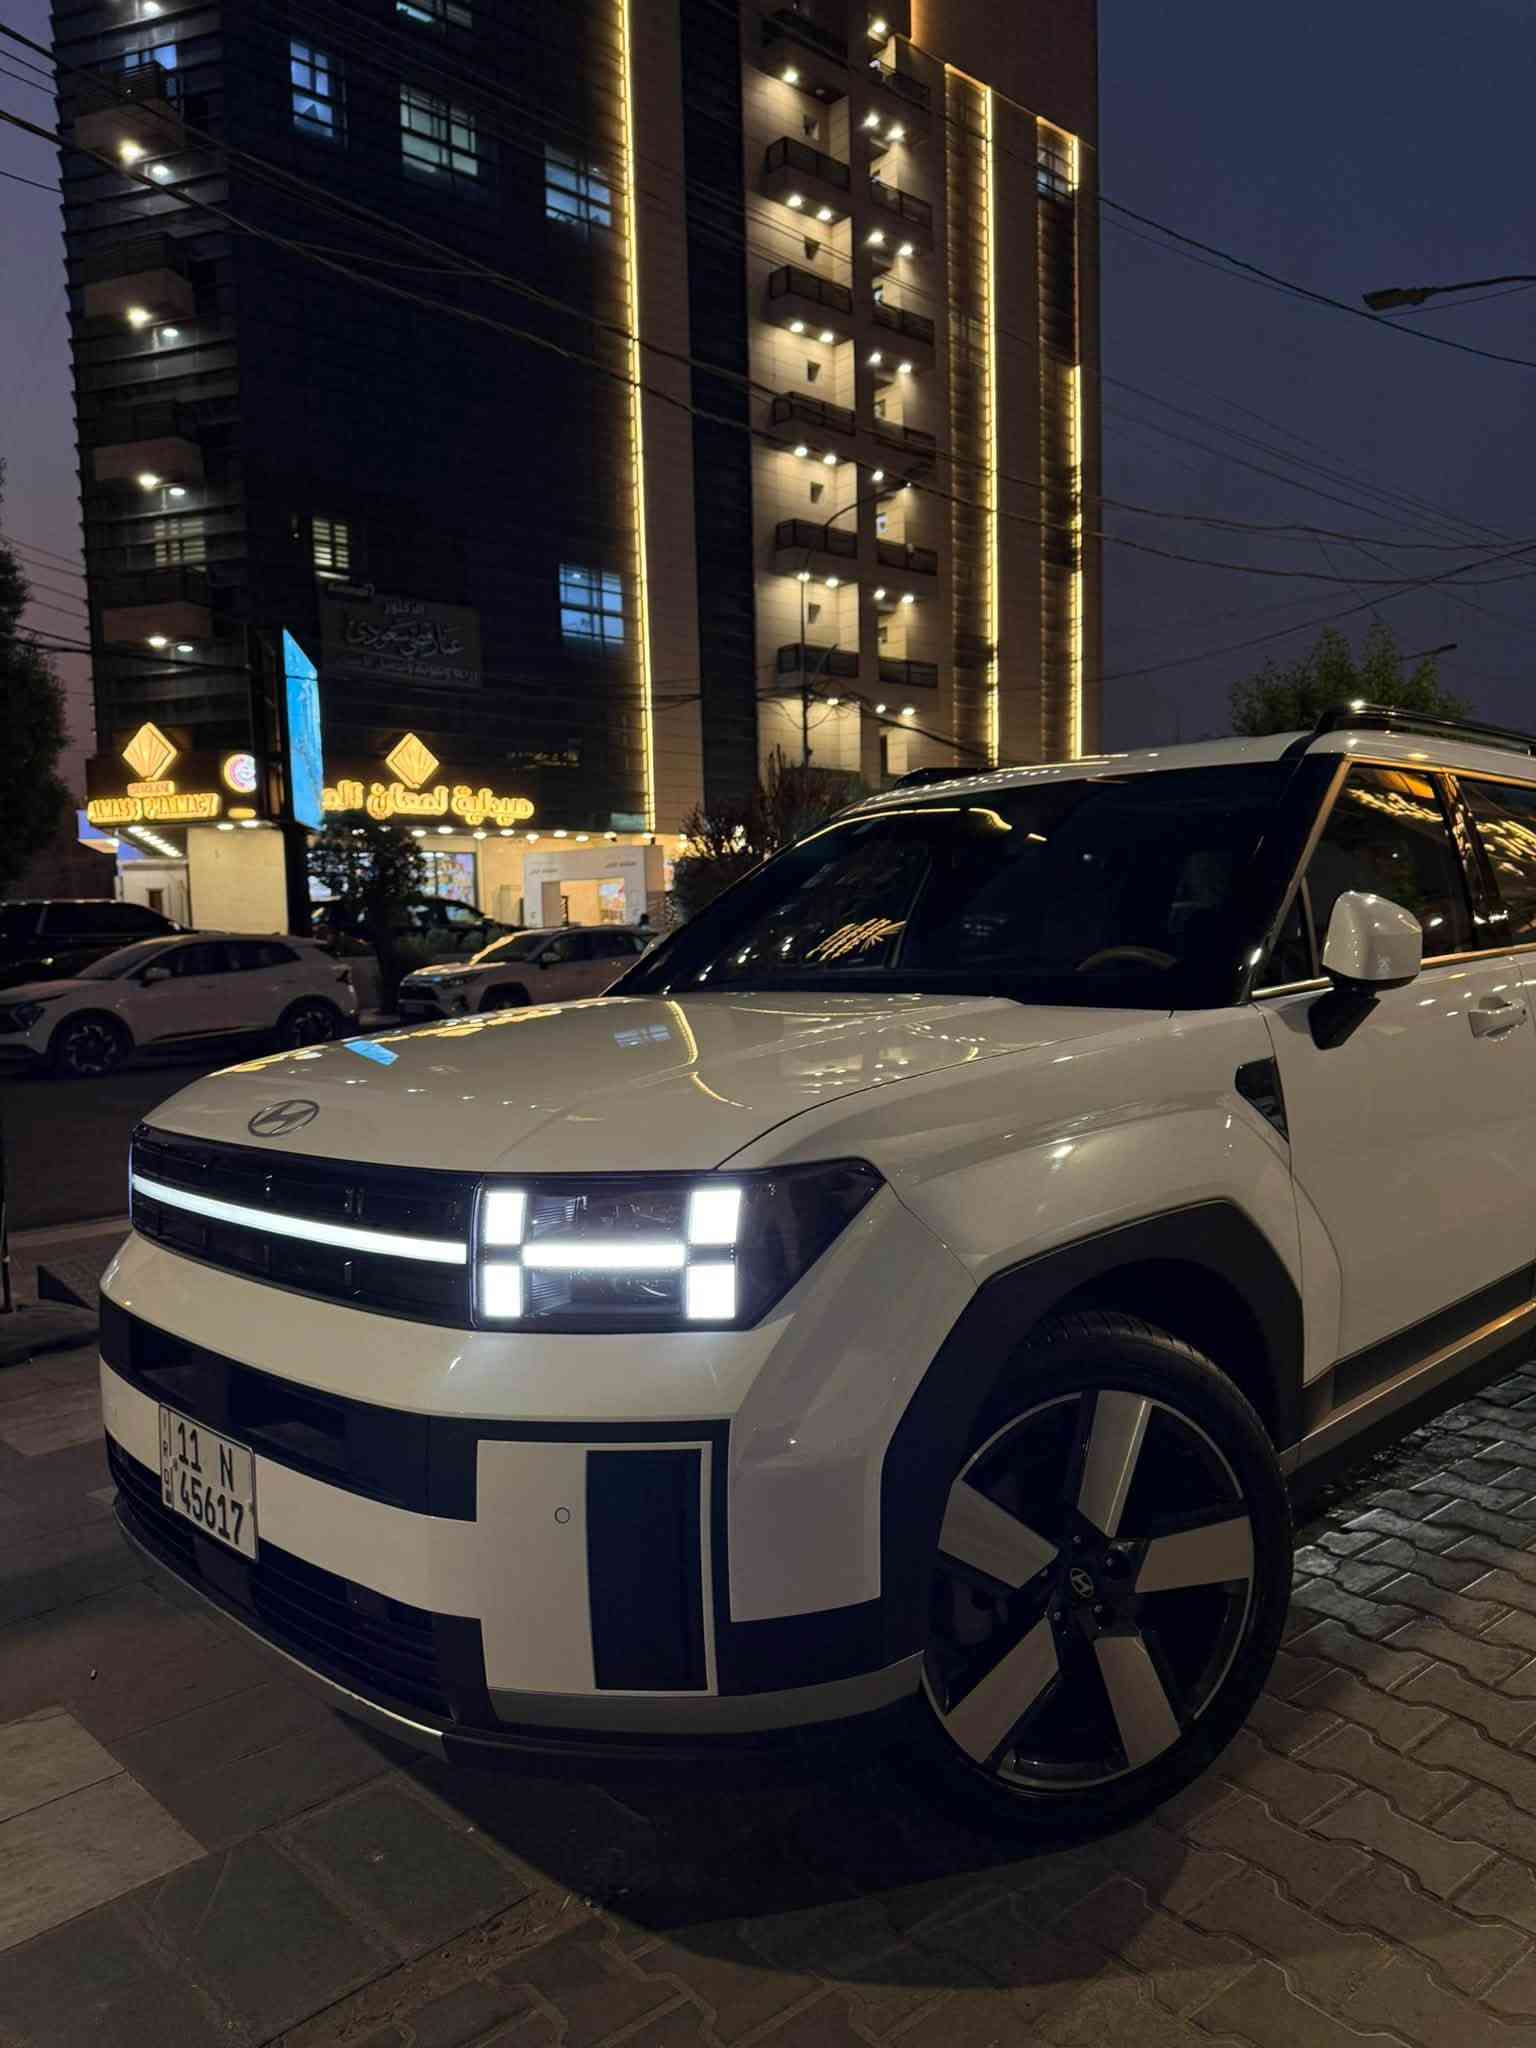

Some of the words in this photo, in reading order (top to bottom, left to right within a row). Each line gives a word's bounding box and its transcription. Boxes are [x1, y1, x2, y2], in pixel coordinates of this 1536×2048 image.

[143, 793, 219, 819] PHARMACY
[321, 780, 363, 811] الم
[367, 782, 449, 820] لمعان
[451, 786, 534, 825] صيدلية
[177, 1422, 202, 1474] 11
[219, 1443, 234, 1492] N
[180, 1470, 244, 1545] 45617
